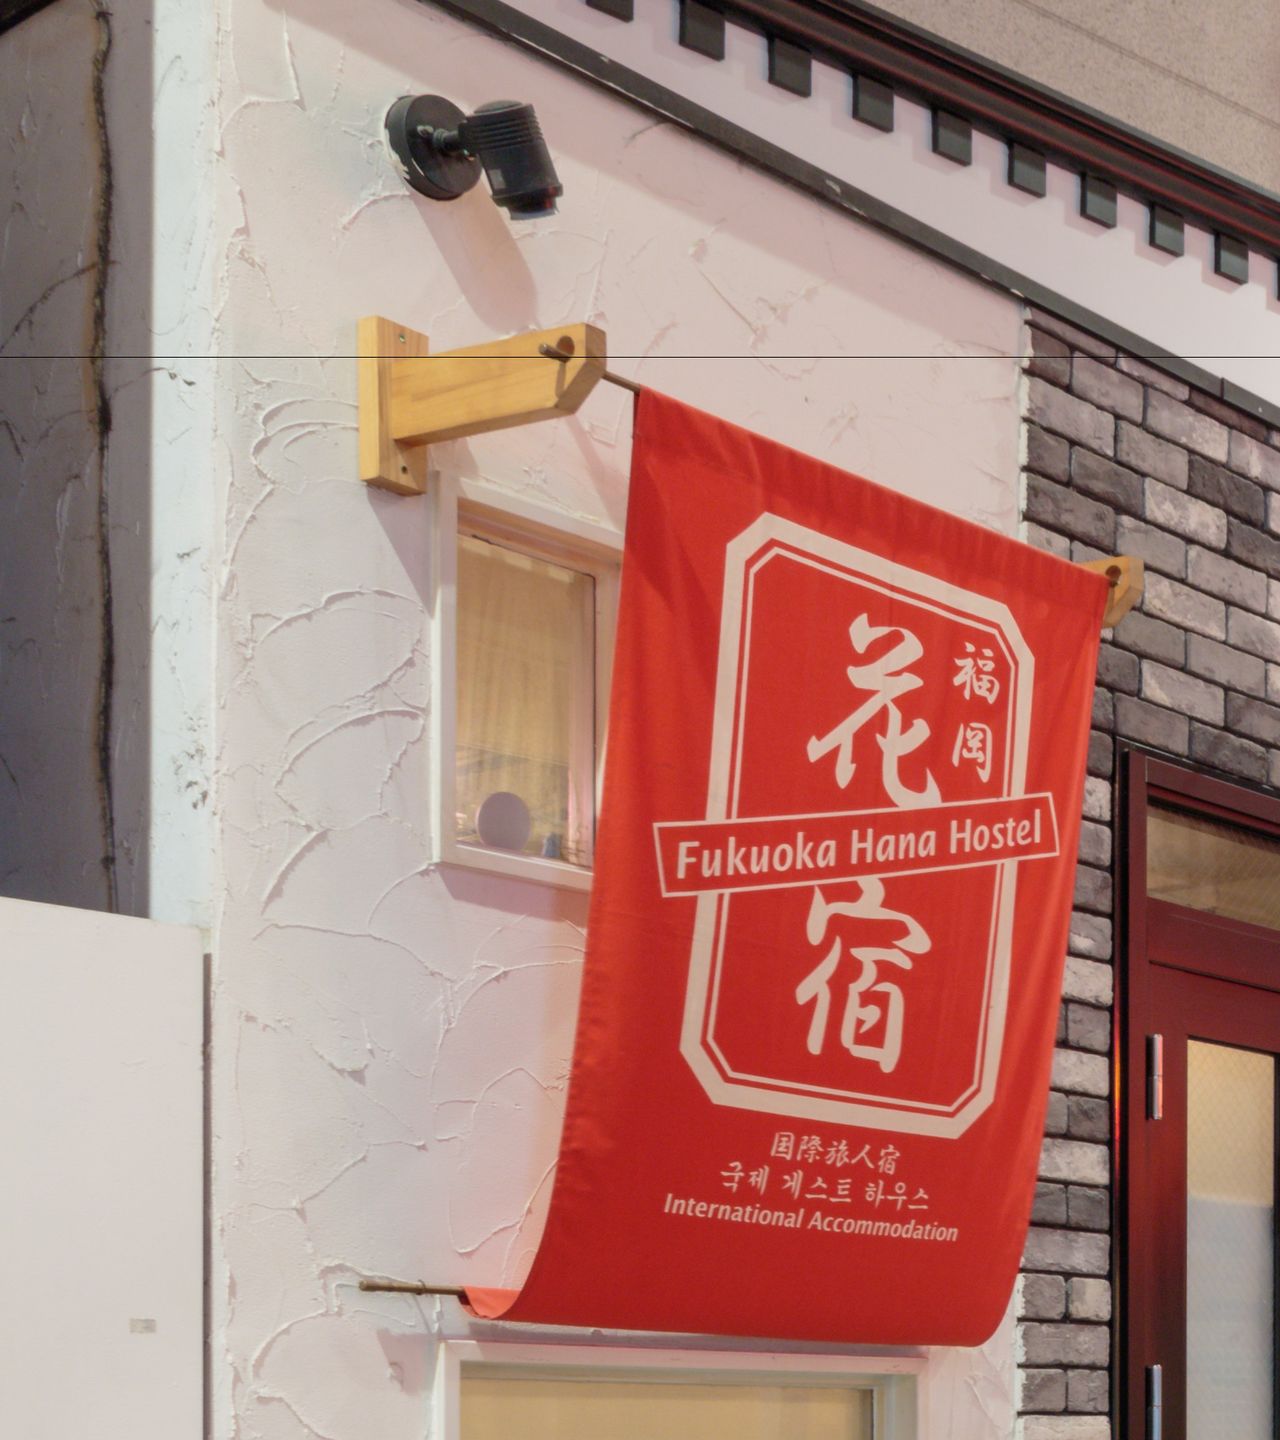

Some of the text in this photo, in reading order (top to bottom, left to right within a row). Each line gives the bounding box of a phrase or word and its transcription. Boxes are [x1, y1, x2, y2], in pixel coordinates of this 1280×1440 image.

[952, 643, 1000, 783] 福岡
[677, 808, 1041, 879] Fukuoka Hana Hostel
[770, 1132, 900, 1175] 国際旅人宿
[720, 1161, 929, 1211] 국제 게스트 하우스
[664, 1193, 958, 1241] International Accommodation
